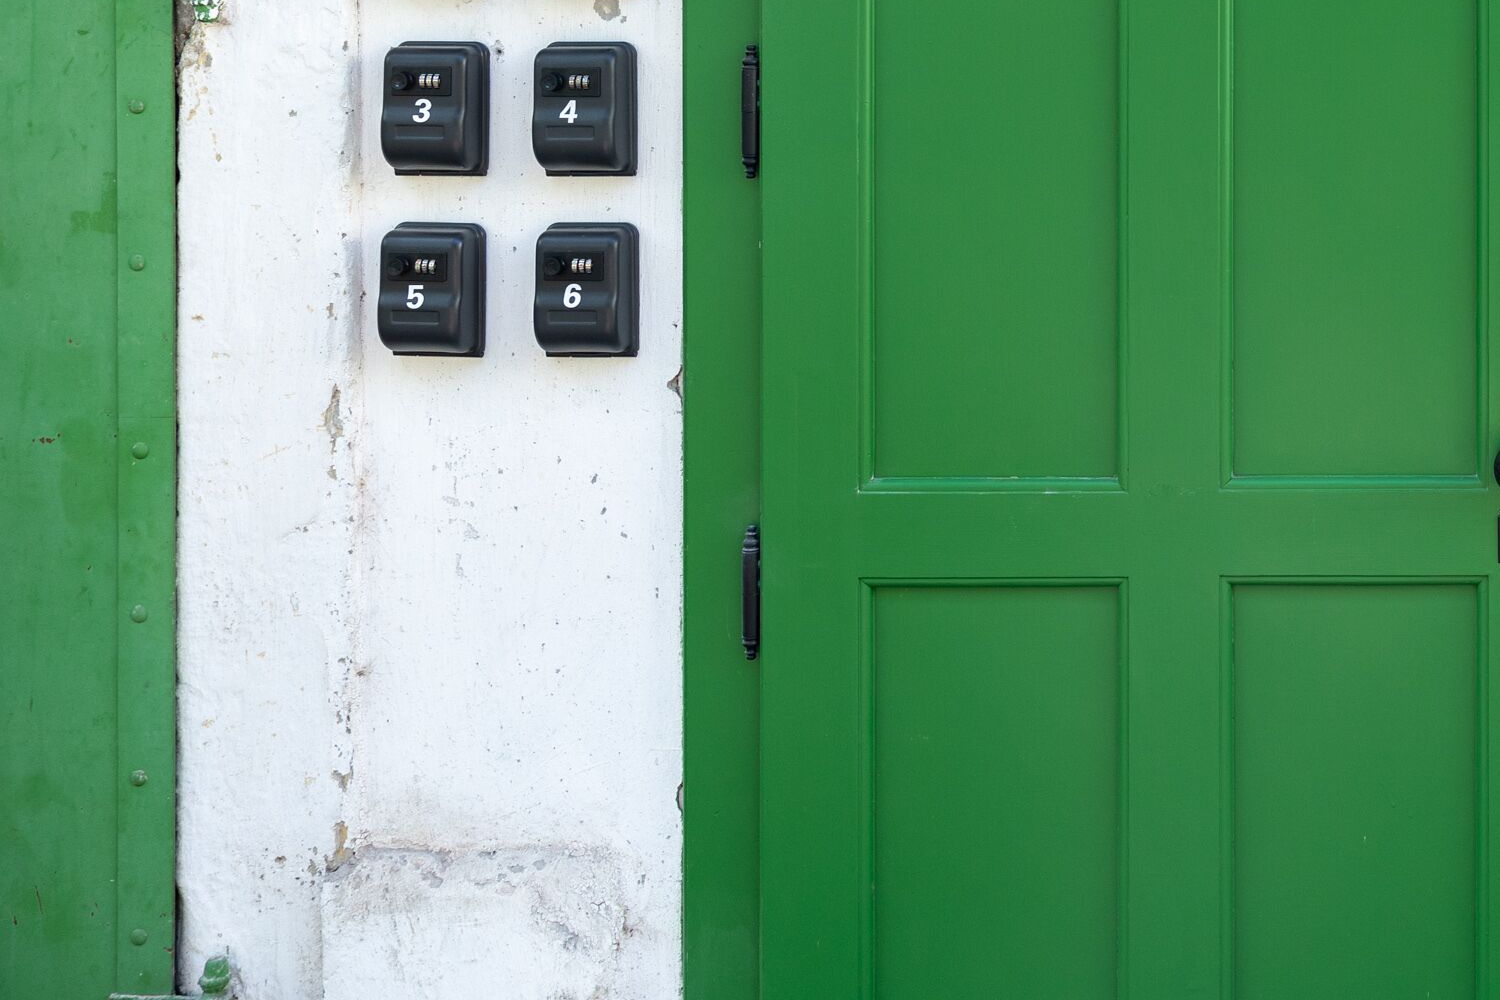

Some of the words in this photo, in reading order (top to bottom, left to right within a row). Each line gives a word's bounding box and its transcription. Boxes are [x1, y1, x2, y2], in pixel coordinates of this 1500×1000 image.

[412, 98, 432, 123] 3
[558, 99, 579, 124] 4
[405, 284, 425, 309] 5
[563, 283, 582, 308] 6
